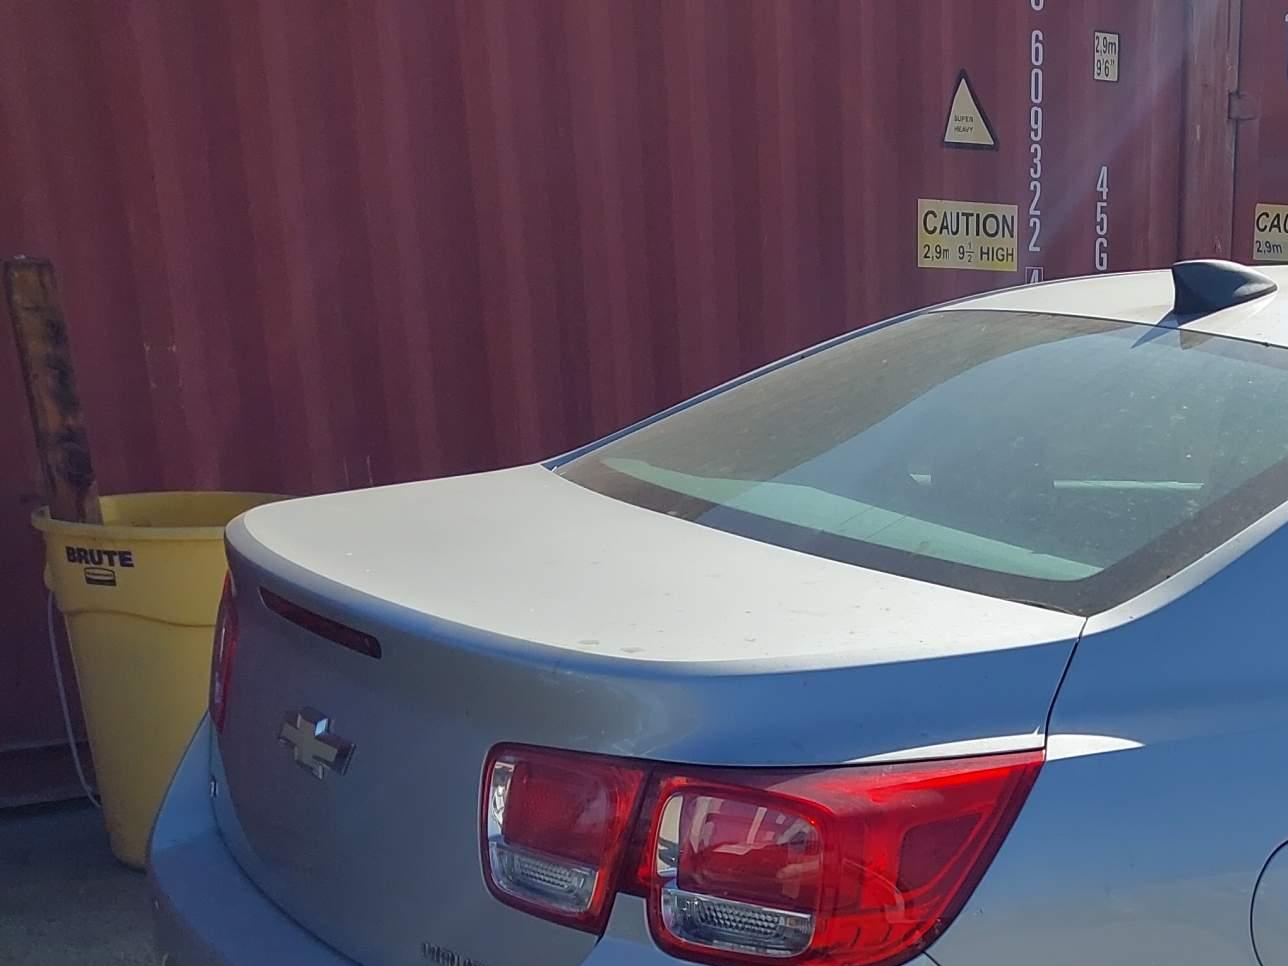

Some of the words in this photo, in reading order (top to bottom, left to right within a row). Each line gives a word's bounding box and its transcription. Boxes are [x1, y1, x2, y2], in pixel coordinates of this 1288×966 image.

[953, 125, 974, 134] HEAVY
[923, 209, 1015, 239] CAUTION
[980, 246, 1014, 263] HIGH
[65, 546, 135, 568] BRUTE
